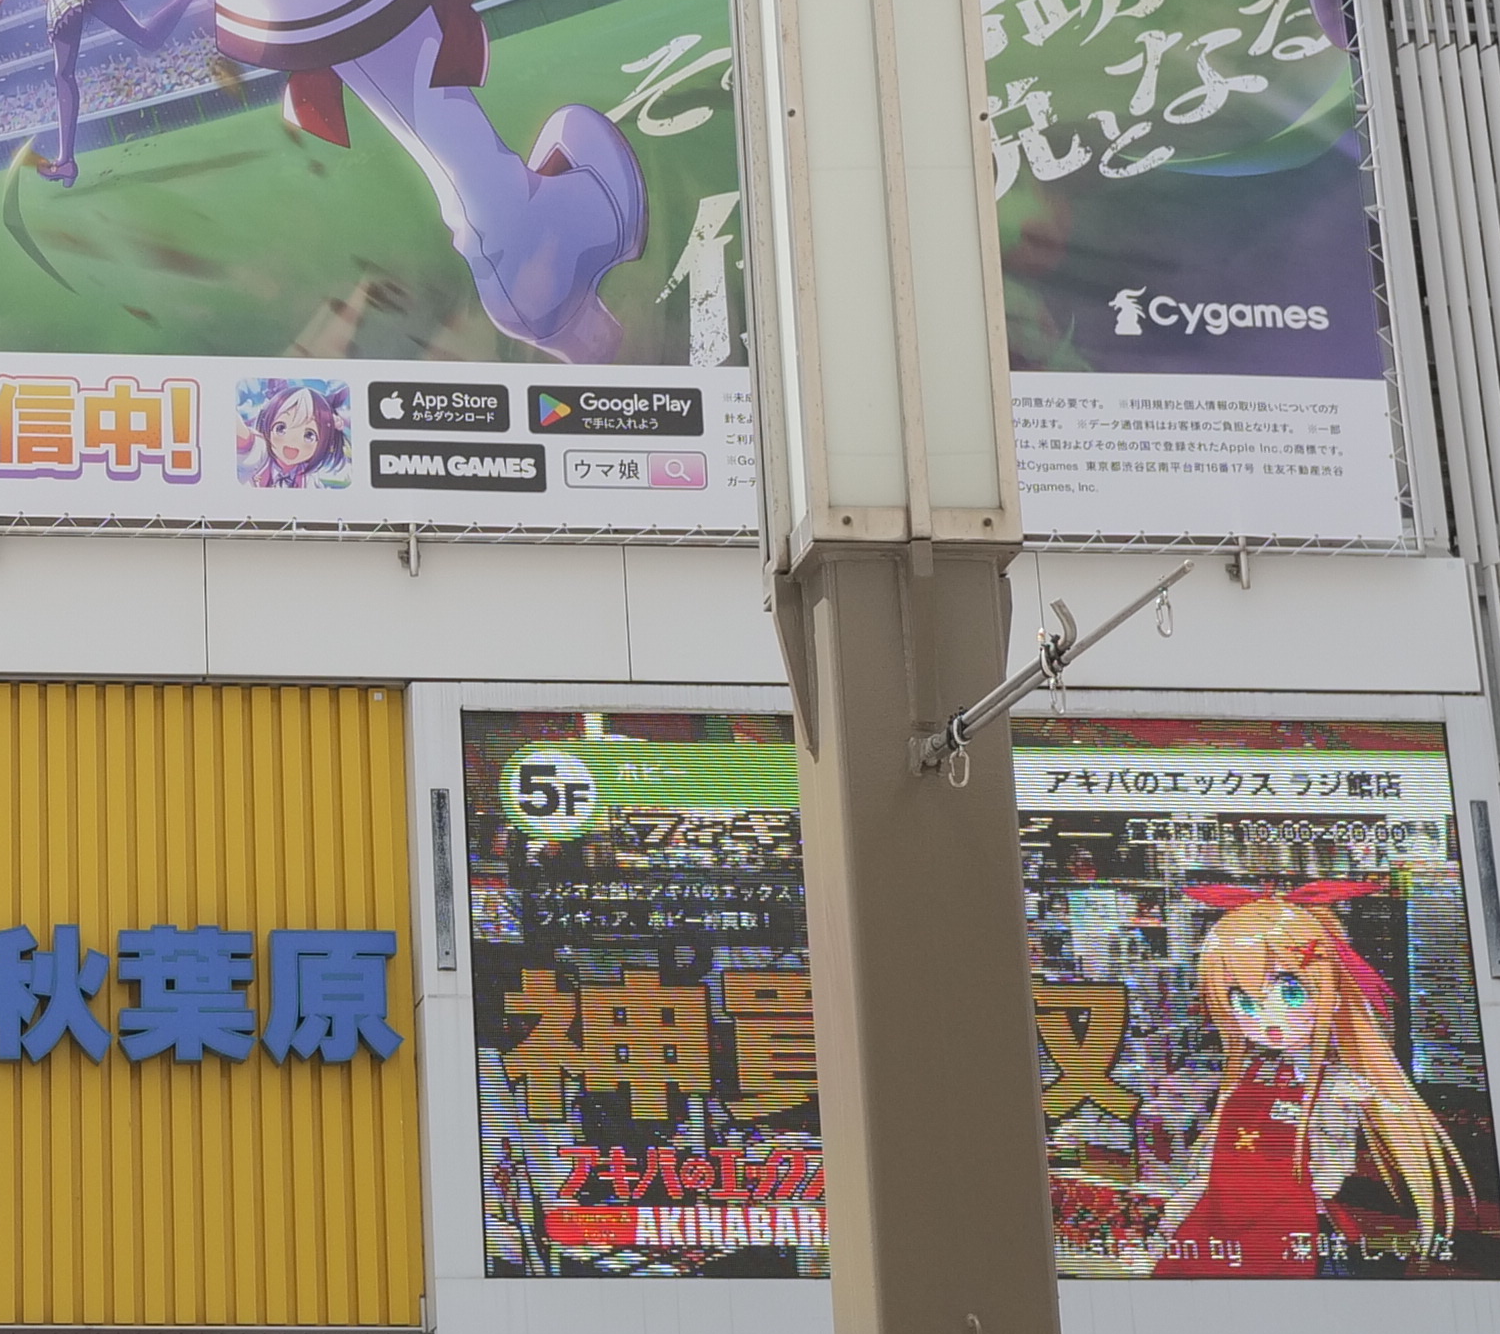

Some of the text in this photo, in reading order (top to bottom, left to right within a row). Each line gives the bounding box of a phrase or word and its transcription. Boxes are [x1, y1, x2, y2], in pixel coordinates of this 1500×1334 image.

[1148, 295, 1330, 336] Cygames
[412, 391, 498, 412] App Store
[579, 392, 692, 417] Google Play
[412, 410, 496, 424] からダウンロード
[581, 417, 660, 431] で手に入れよう
[379, 454, 538, 480] DMM GAMES
[573, 459, 641, 481] ウマ娘
[1077, 481, 1101, 494] Inc.
[519, 764, 591, 818] 5F
[1045, 768, 1277, 797] アキバのエックス
[635, 1206, 829, 1247] AKIHABAR
